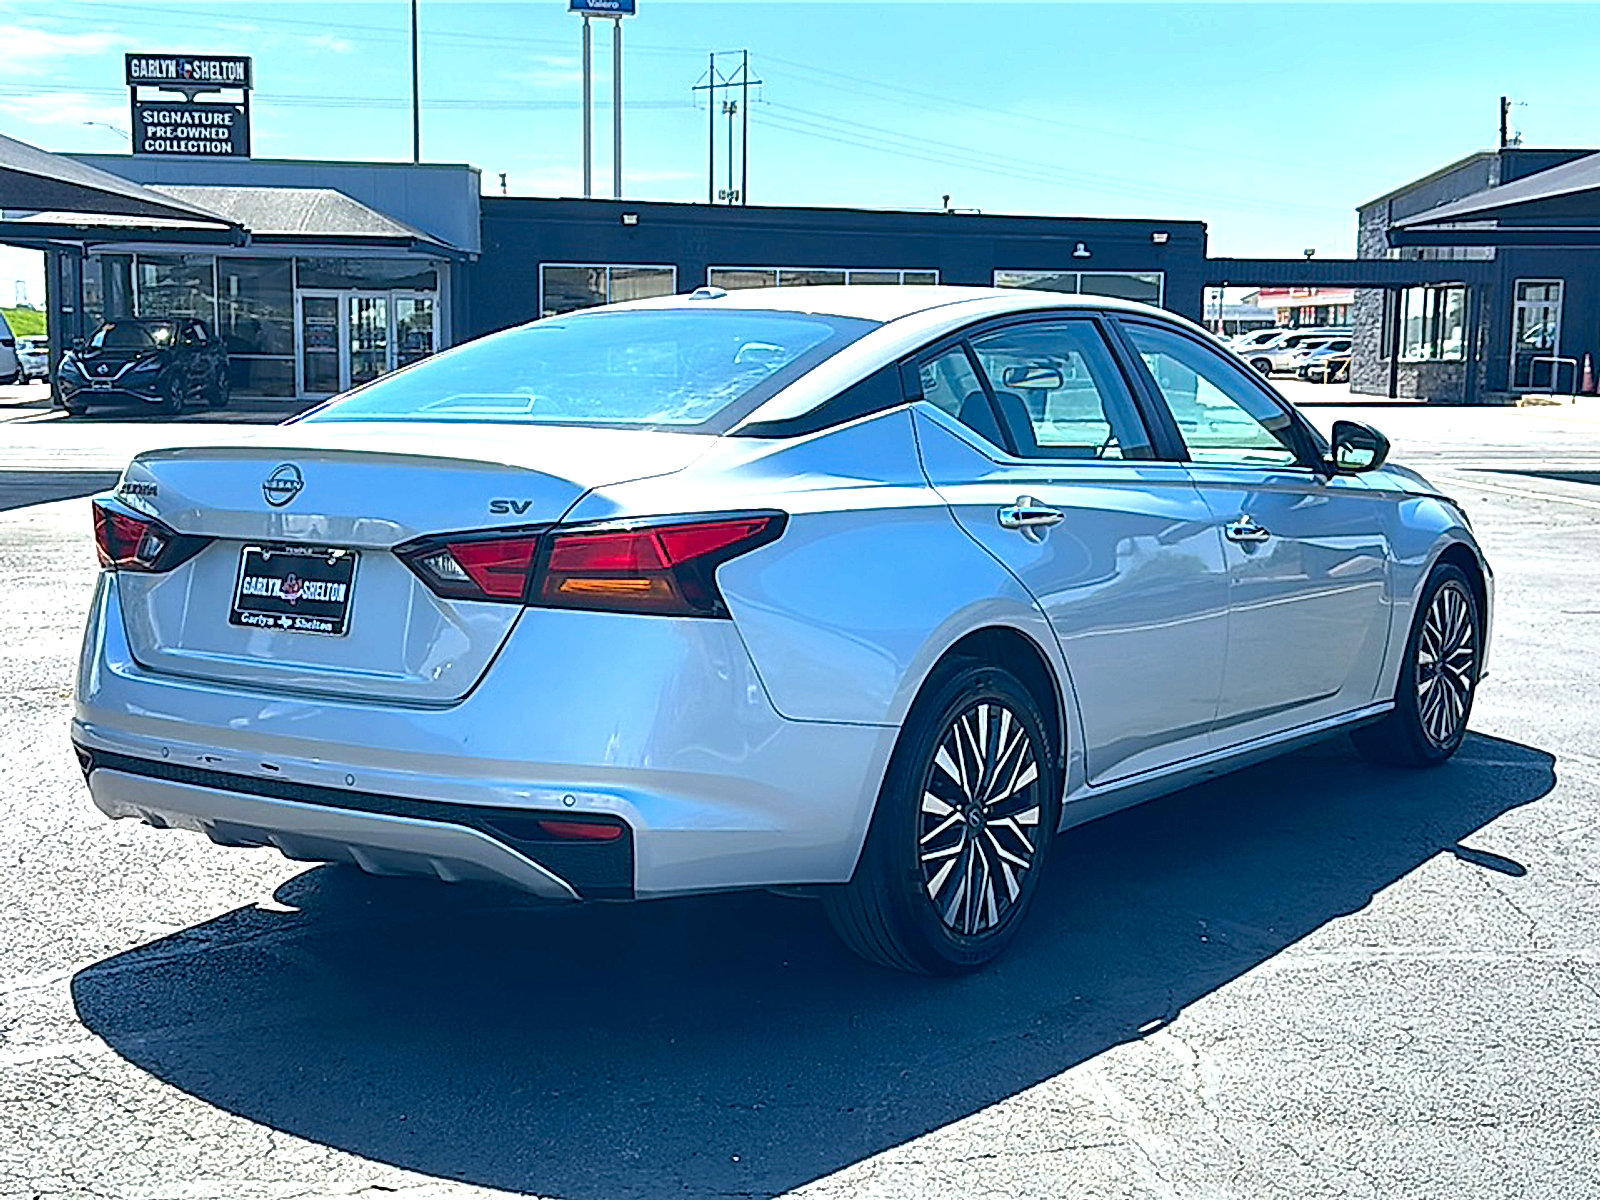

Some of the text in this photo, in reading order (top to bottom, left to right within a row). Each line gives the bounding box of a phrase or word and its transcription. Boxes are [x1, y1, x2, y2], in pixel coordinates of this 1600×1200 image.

[131, 59, 245, 80] GARLYN SHELTON
[142, 110, 234, 126] SIGNATURE
[146, 126, 229, 140] PRE-OWNED
[144, 140, 233, 153] COLLECTION
[489, 500, 533, 515] SV
[242, 576, 347, 602] GARLYN SHELTON
[241, 612, 333, 631] Garlyn Shelton
